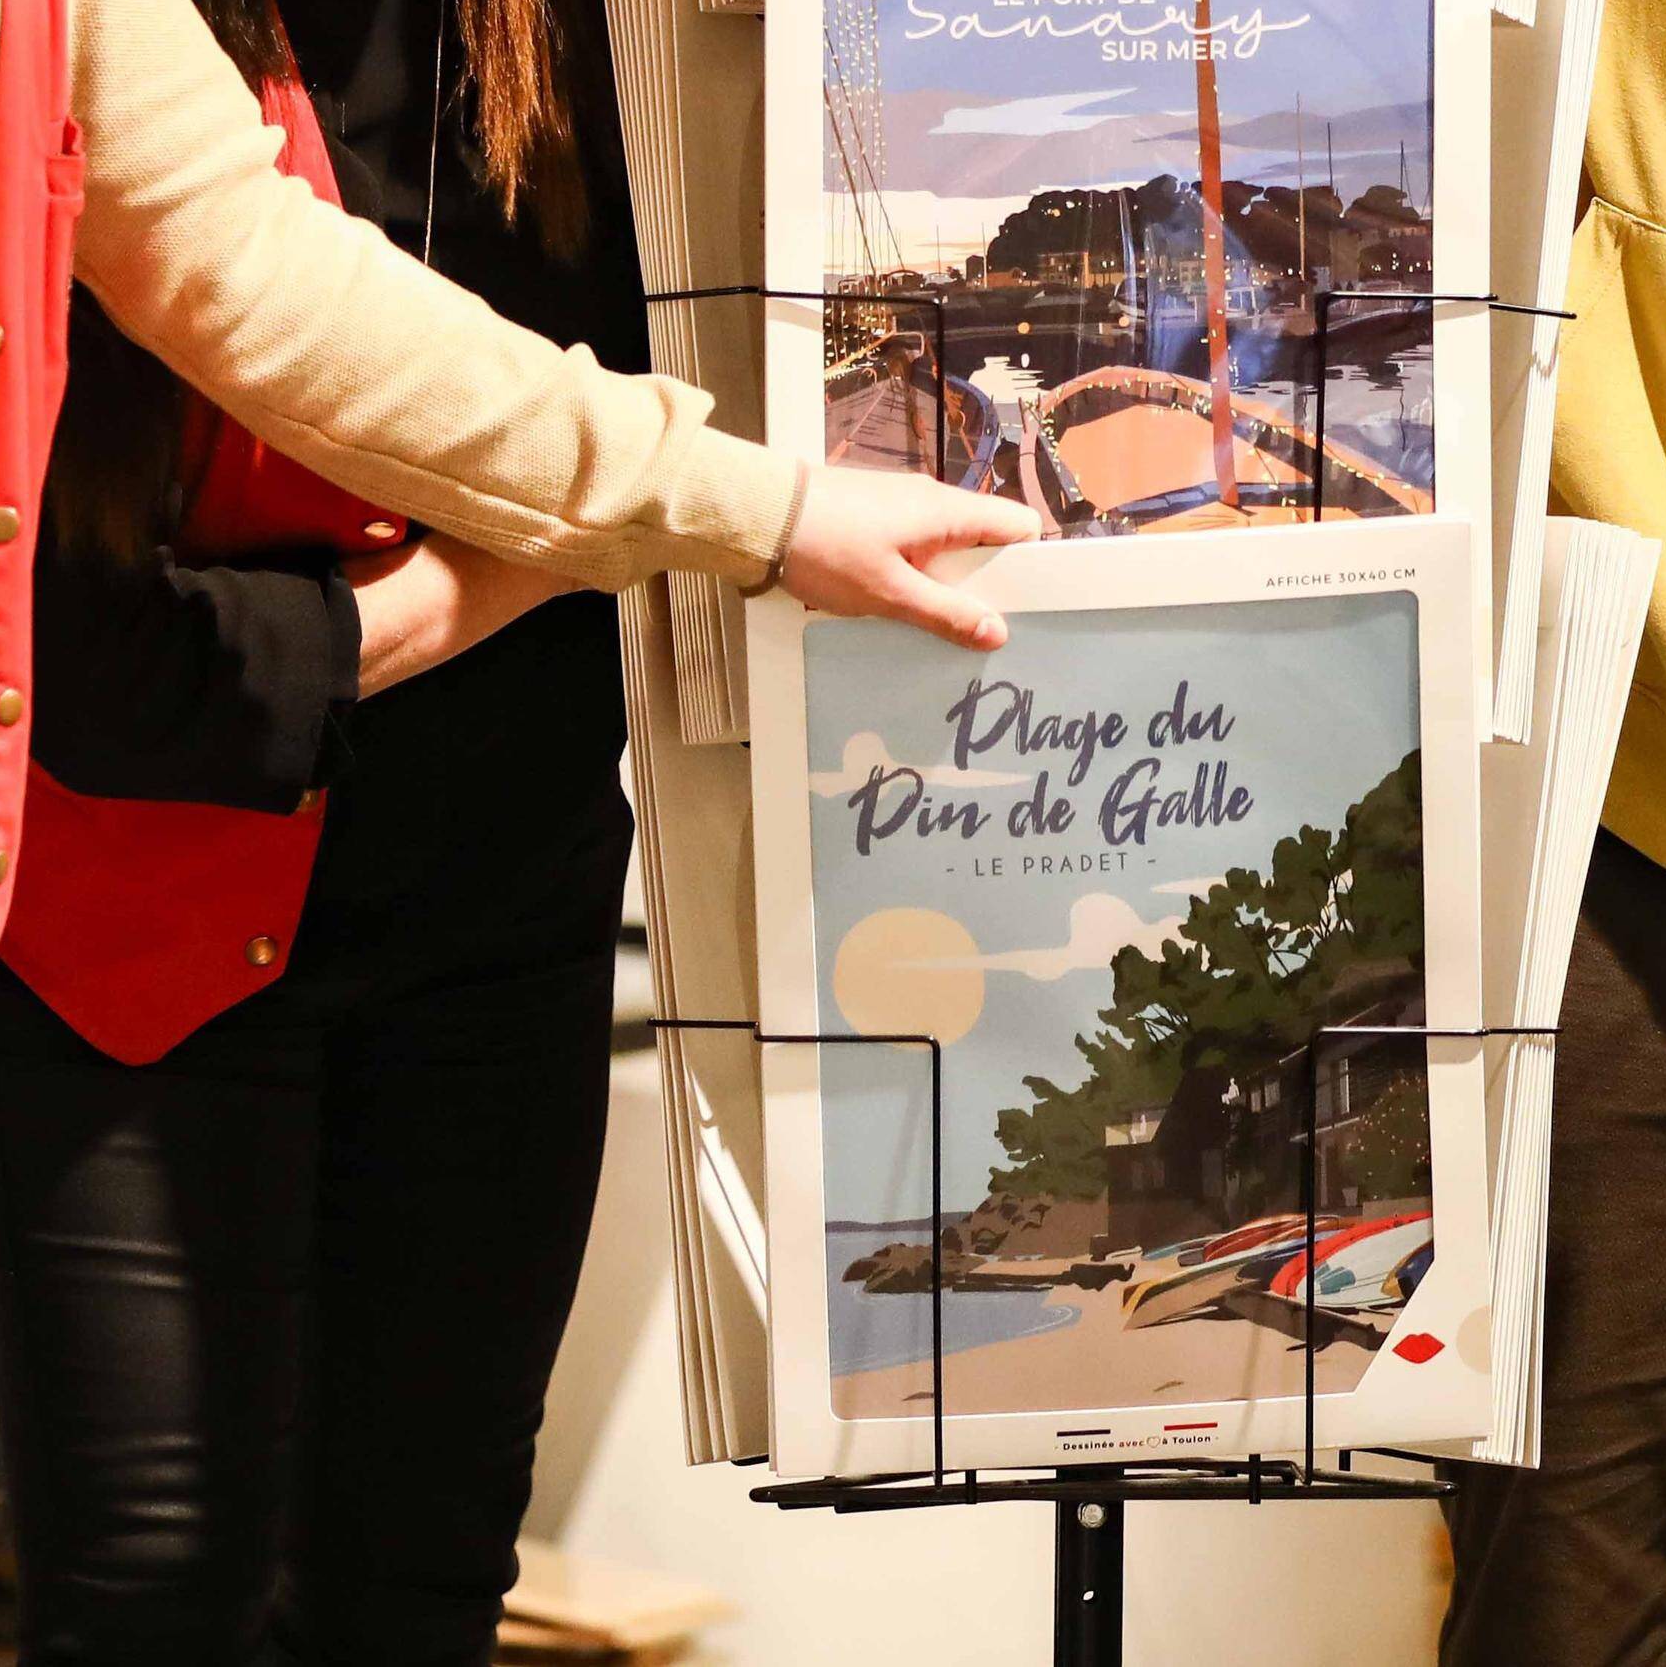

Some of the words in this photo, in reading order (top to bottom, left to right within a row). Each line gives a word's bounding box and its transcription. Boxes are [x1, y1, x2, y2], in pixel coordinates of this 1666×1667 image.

[1101, 40, 1158, 61] SUR
[1167, 40, 1228, 61] MER
[1266, 573, 1333, 588] AFFICHE
[1393, 568, 1416, 580] CM
[945, 678, 1129, 787] Plage
[1147, 679, 1236, 748] du
[1007, 770, 1077, 839] de
[1098, 757, 1254, 846] Galle
[974, 857, 1003, 877] LE
[1023, 852, 1129, 875] PRADET
[1062, 1440, 1115, 1451] Dessinée
[1118, 1439, 1145, 1449] avec
[1161, 1437, 1168, 1445] à
[1172, 1435, 1211, 1445] Toulon
